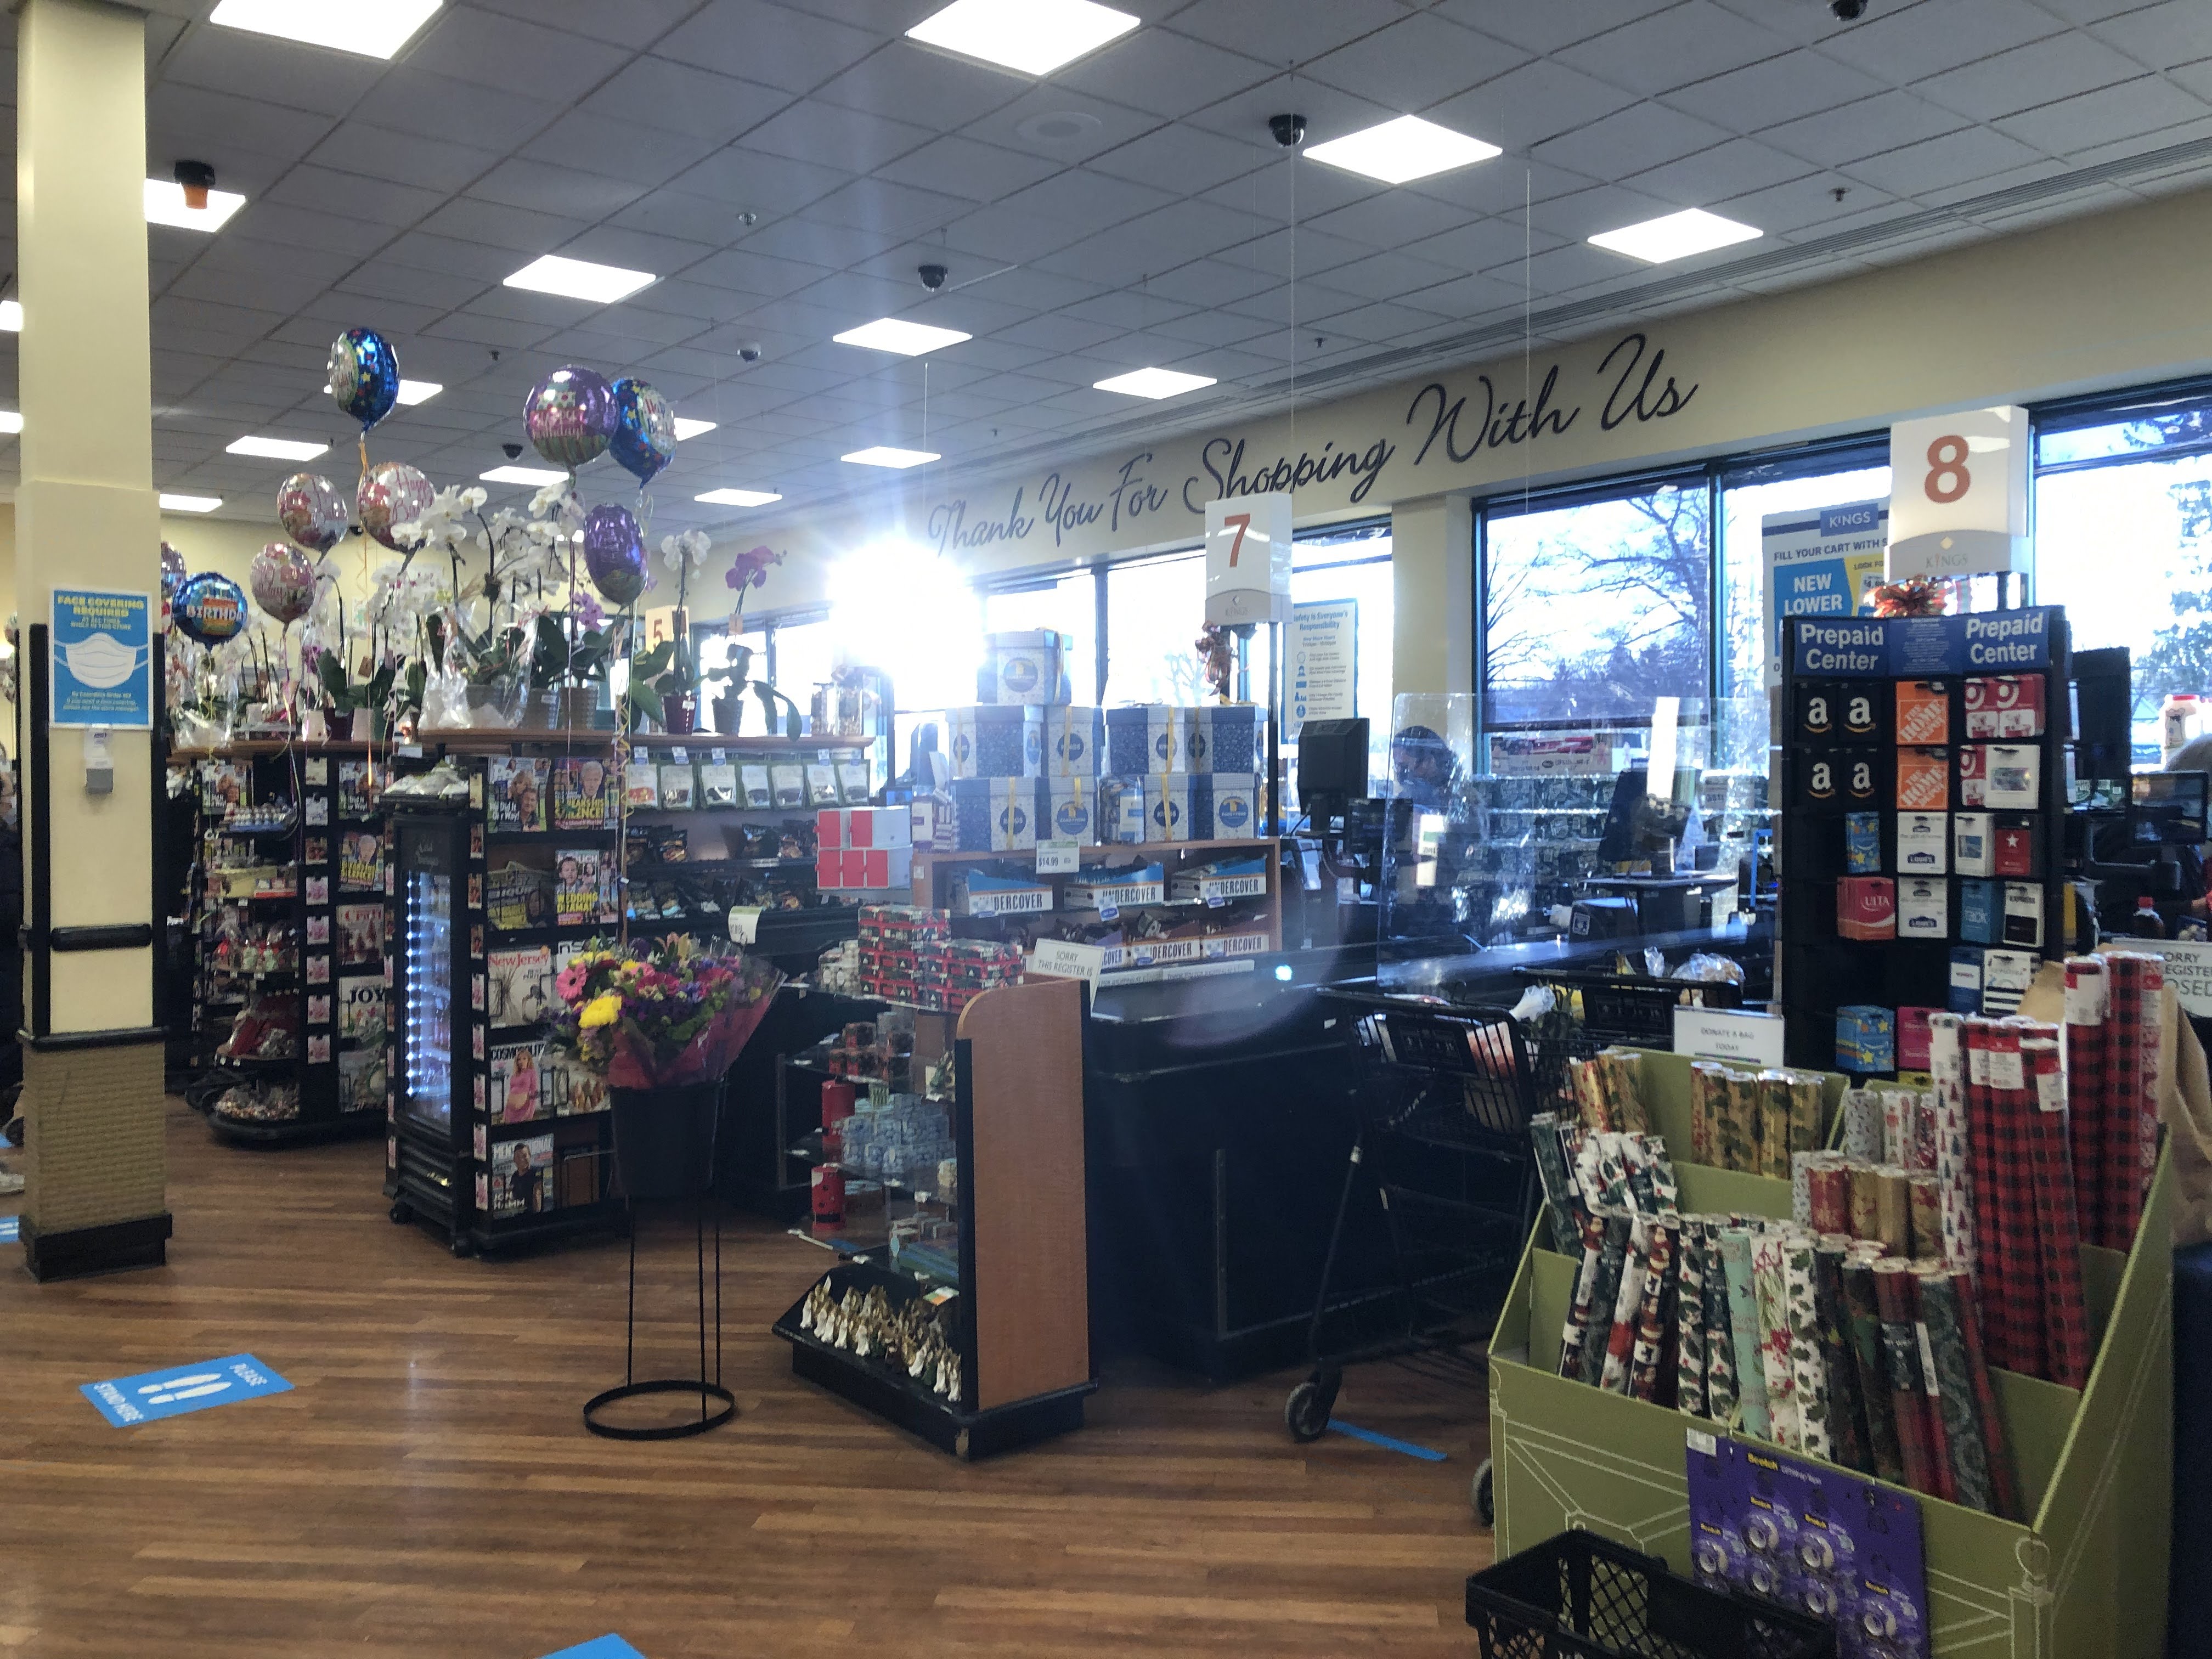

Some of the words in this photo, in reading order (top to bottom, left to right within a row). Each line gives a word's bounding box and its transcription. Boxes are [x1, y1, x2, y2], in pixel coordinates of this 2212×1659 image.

[928, 486, 1034, 558] Thank
[1039, 473, 1103, 547] You
[1109, 452, 1169, 532] For
[1183, 438, 1395, 514] Shopping
[1407, 364, 1581, 465] With
[1597, 333, 1699, 432] Us
[1924, 434, 1971, 504] 8
[1829, 511, 1871, 528] KINGS
[1224, 513, 1250, 567] 7
[1774, 550, 1793, 561] FILL
[1795, 546, 1822, 558] YOUR
[1824, 543, 1849, 555] CART
[1853, 539, 1880, 550] WITH
[1926, 552, 1968, 568] KINGS
[1793, 573, 1832, 593] NEW
[1784, 594, 1843, 616] LOWER
[1800, 623, 1884, 649] Prepaid
[1966, 611, 2044, 642] Prepaid
[1805, 648, 1879, 670] Center
[1970, 641, 2038, 665] Center
[1808, 696, 1828, 725] a
[1848, 696, 1871, 725] a
[1812, 763, 1832, 790] a
[1853, 763, 1871, 791] a
[1057, 950, 1080, 962] SORRY
[2157, 951, 2200, 963] ORRY
[1038, 959, 1052, 970] THIS
[1053, 961, 1085, 976] REGISTER
[1087, 966, 1094, 977] IS
[2165, 964, 2212, 977] EGISTE
[1701, 1027, 1730, 1037] DONATE
[1733, 1029, 1738, 1037] A
[1739, 1031, 1755, 1040] BAG
